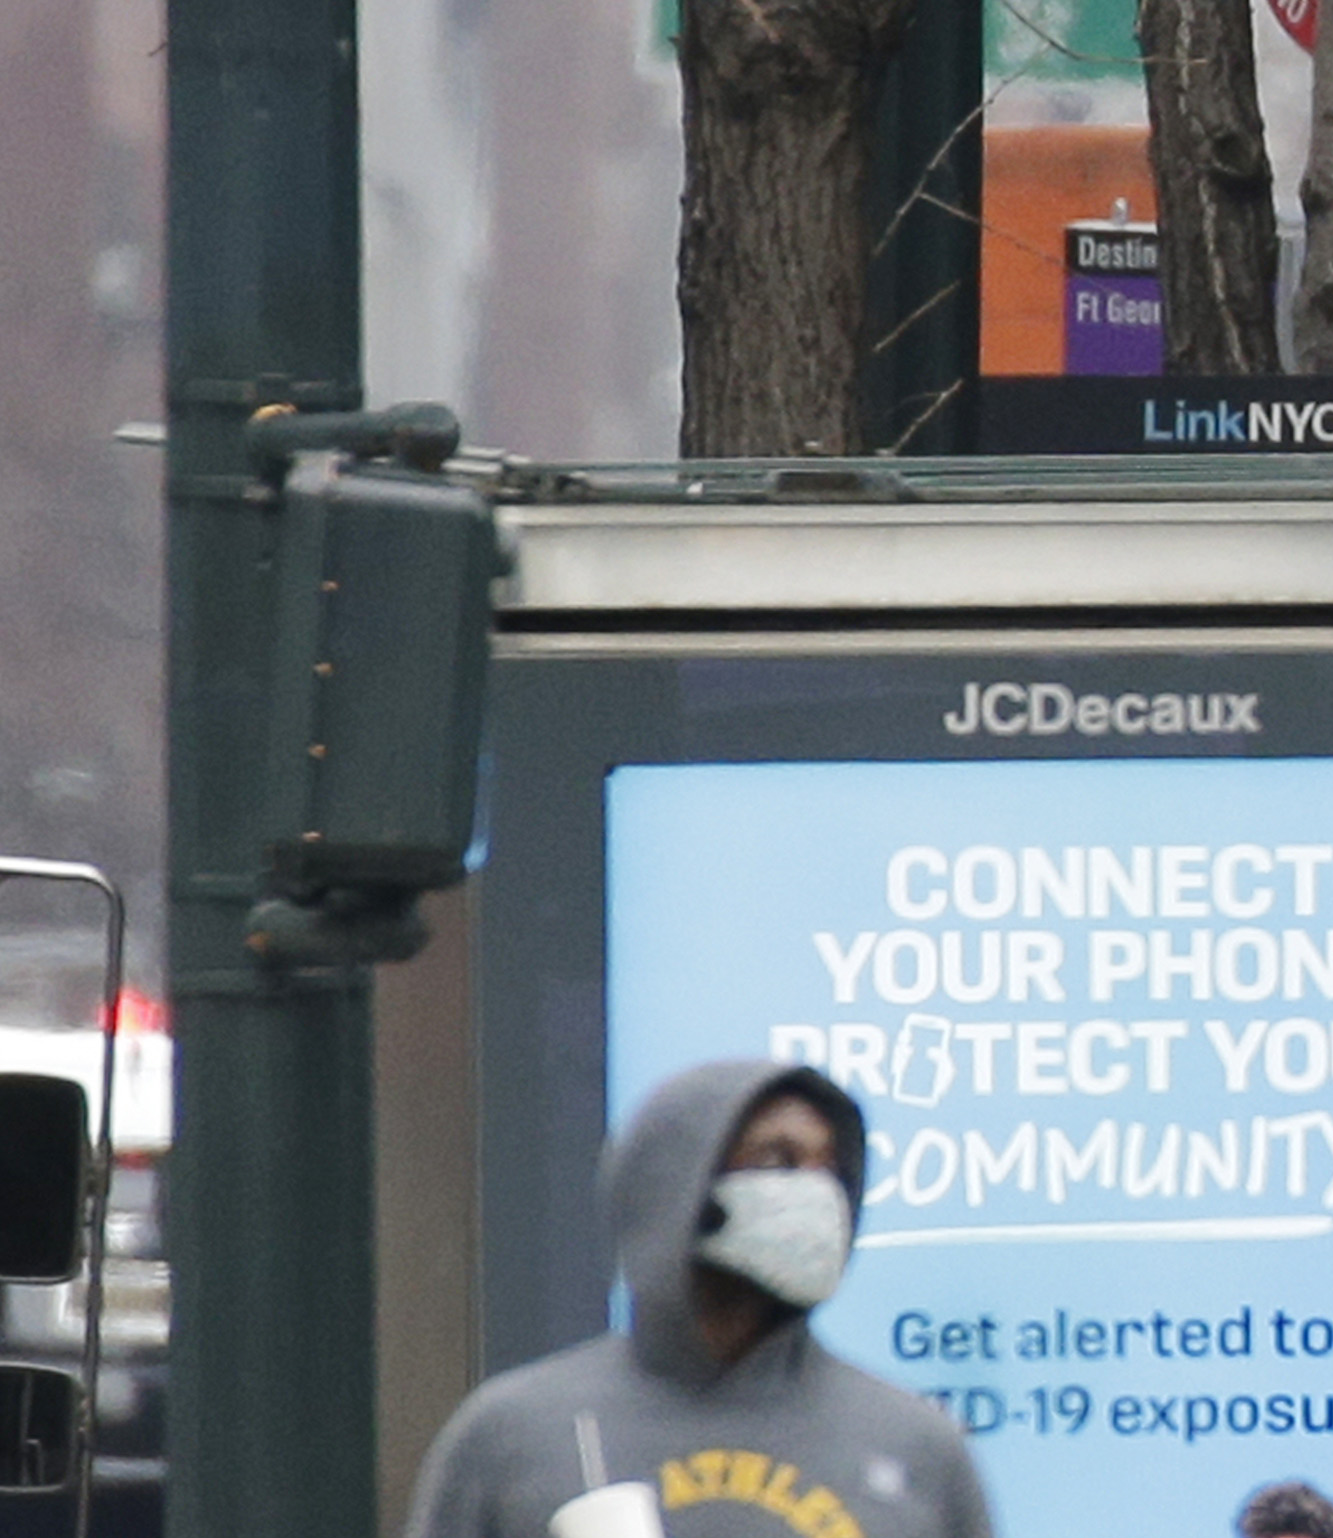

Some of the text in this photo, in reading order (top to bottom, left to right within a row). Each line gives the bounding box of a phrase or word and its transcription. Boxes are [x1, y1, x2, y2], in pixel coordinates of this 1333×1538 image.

[943, 682, 1262, 736] JCDecaux
[813, 929, 1067, 1004] YOUR
[891, 1310, 998, 1362] Get
[1015, 1306, 1253, 1360] alerted
